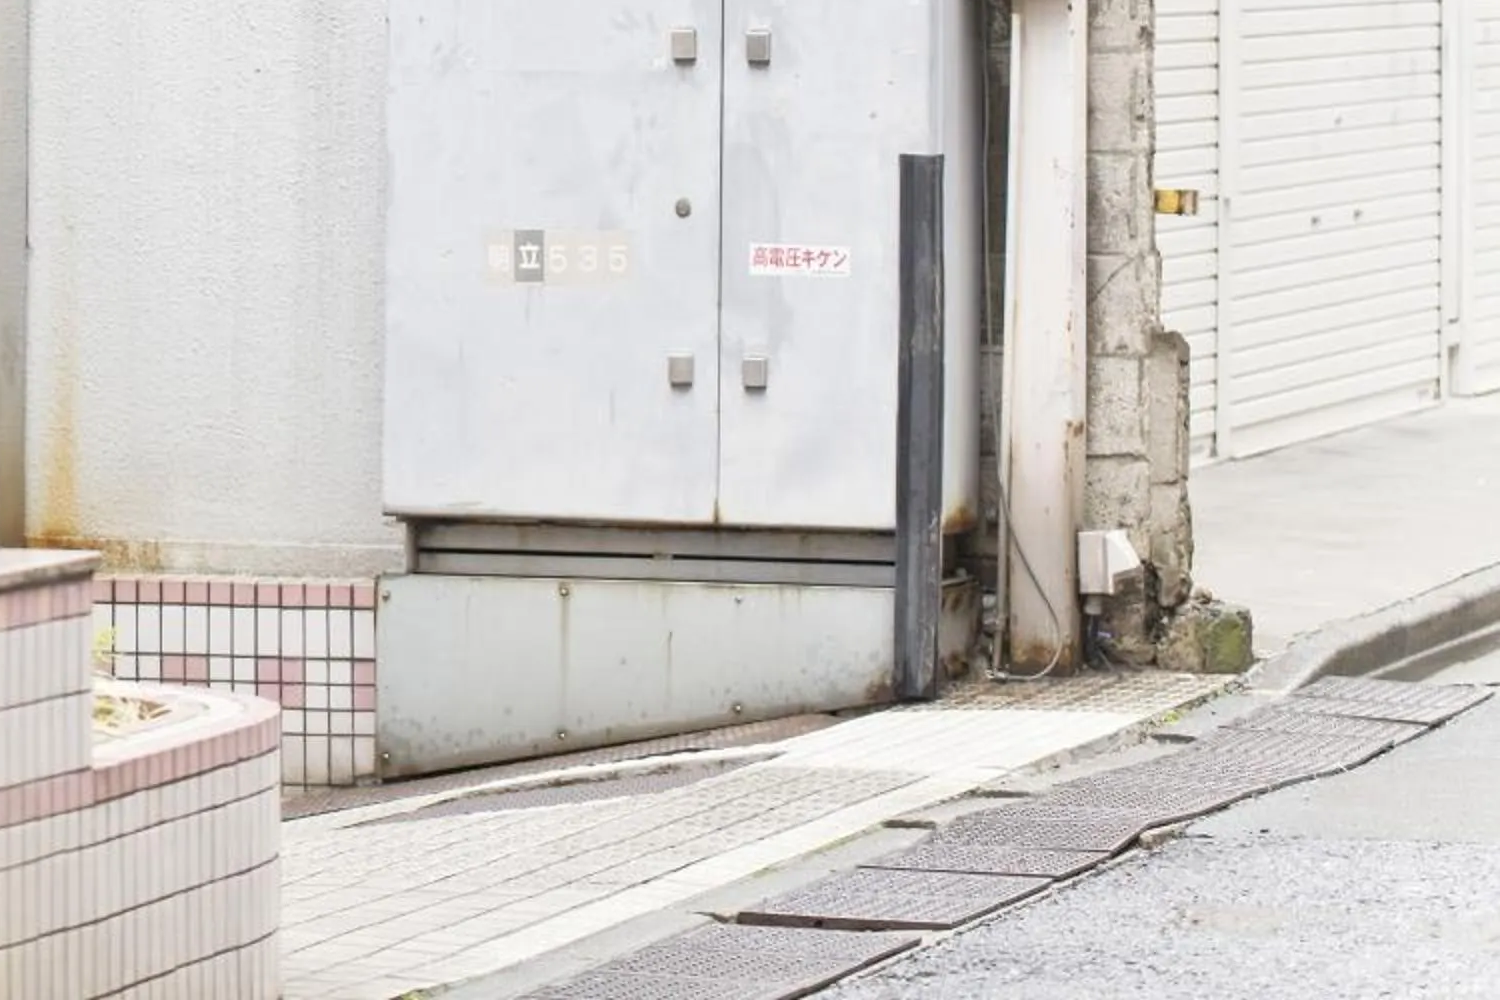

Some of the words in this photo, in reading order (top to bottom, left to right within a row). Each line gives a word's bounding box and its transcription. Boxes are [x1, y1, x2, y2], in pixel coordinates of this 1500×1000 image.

[753, 246, 847, 269] 高電圧キケン
